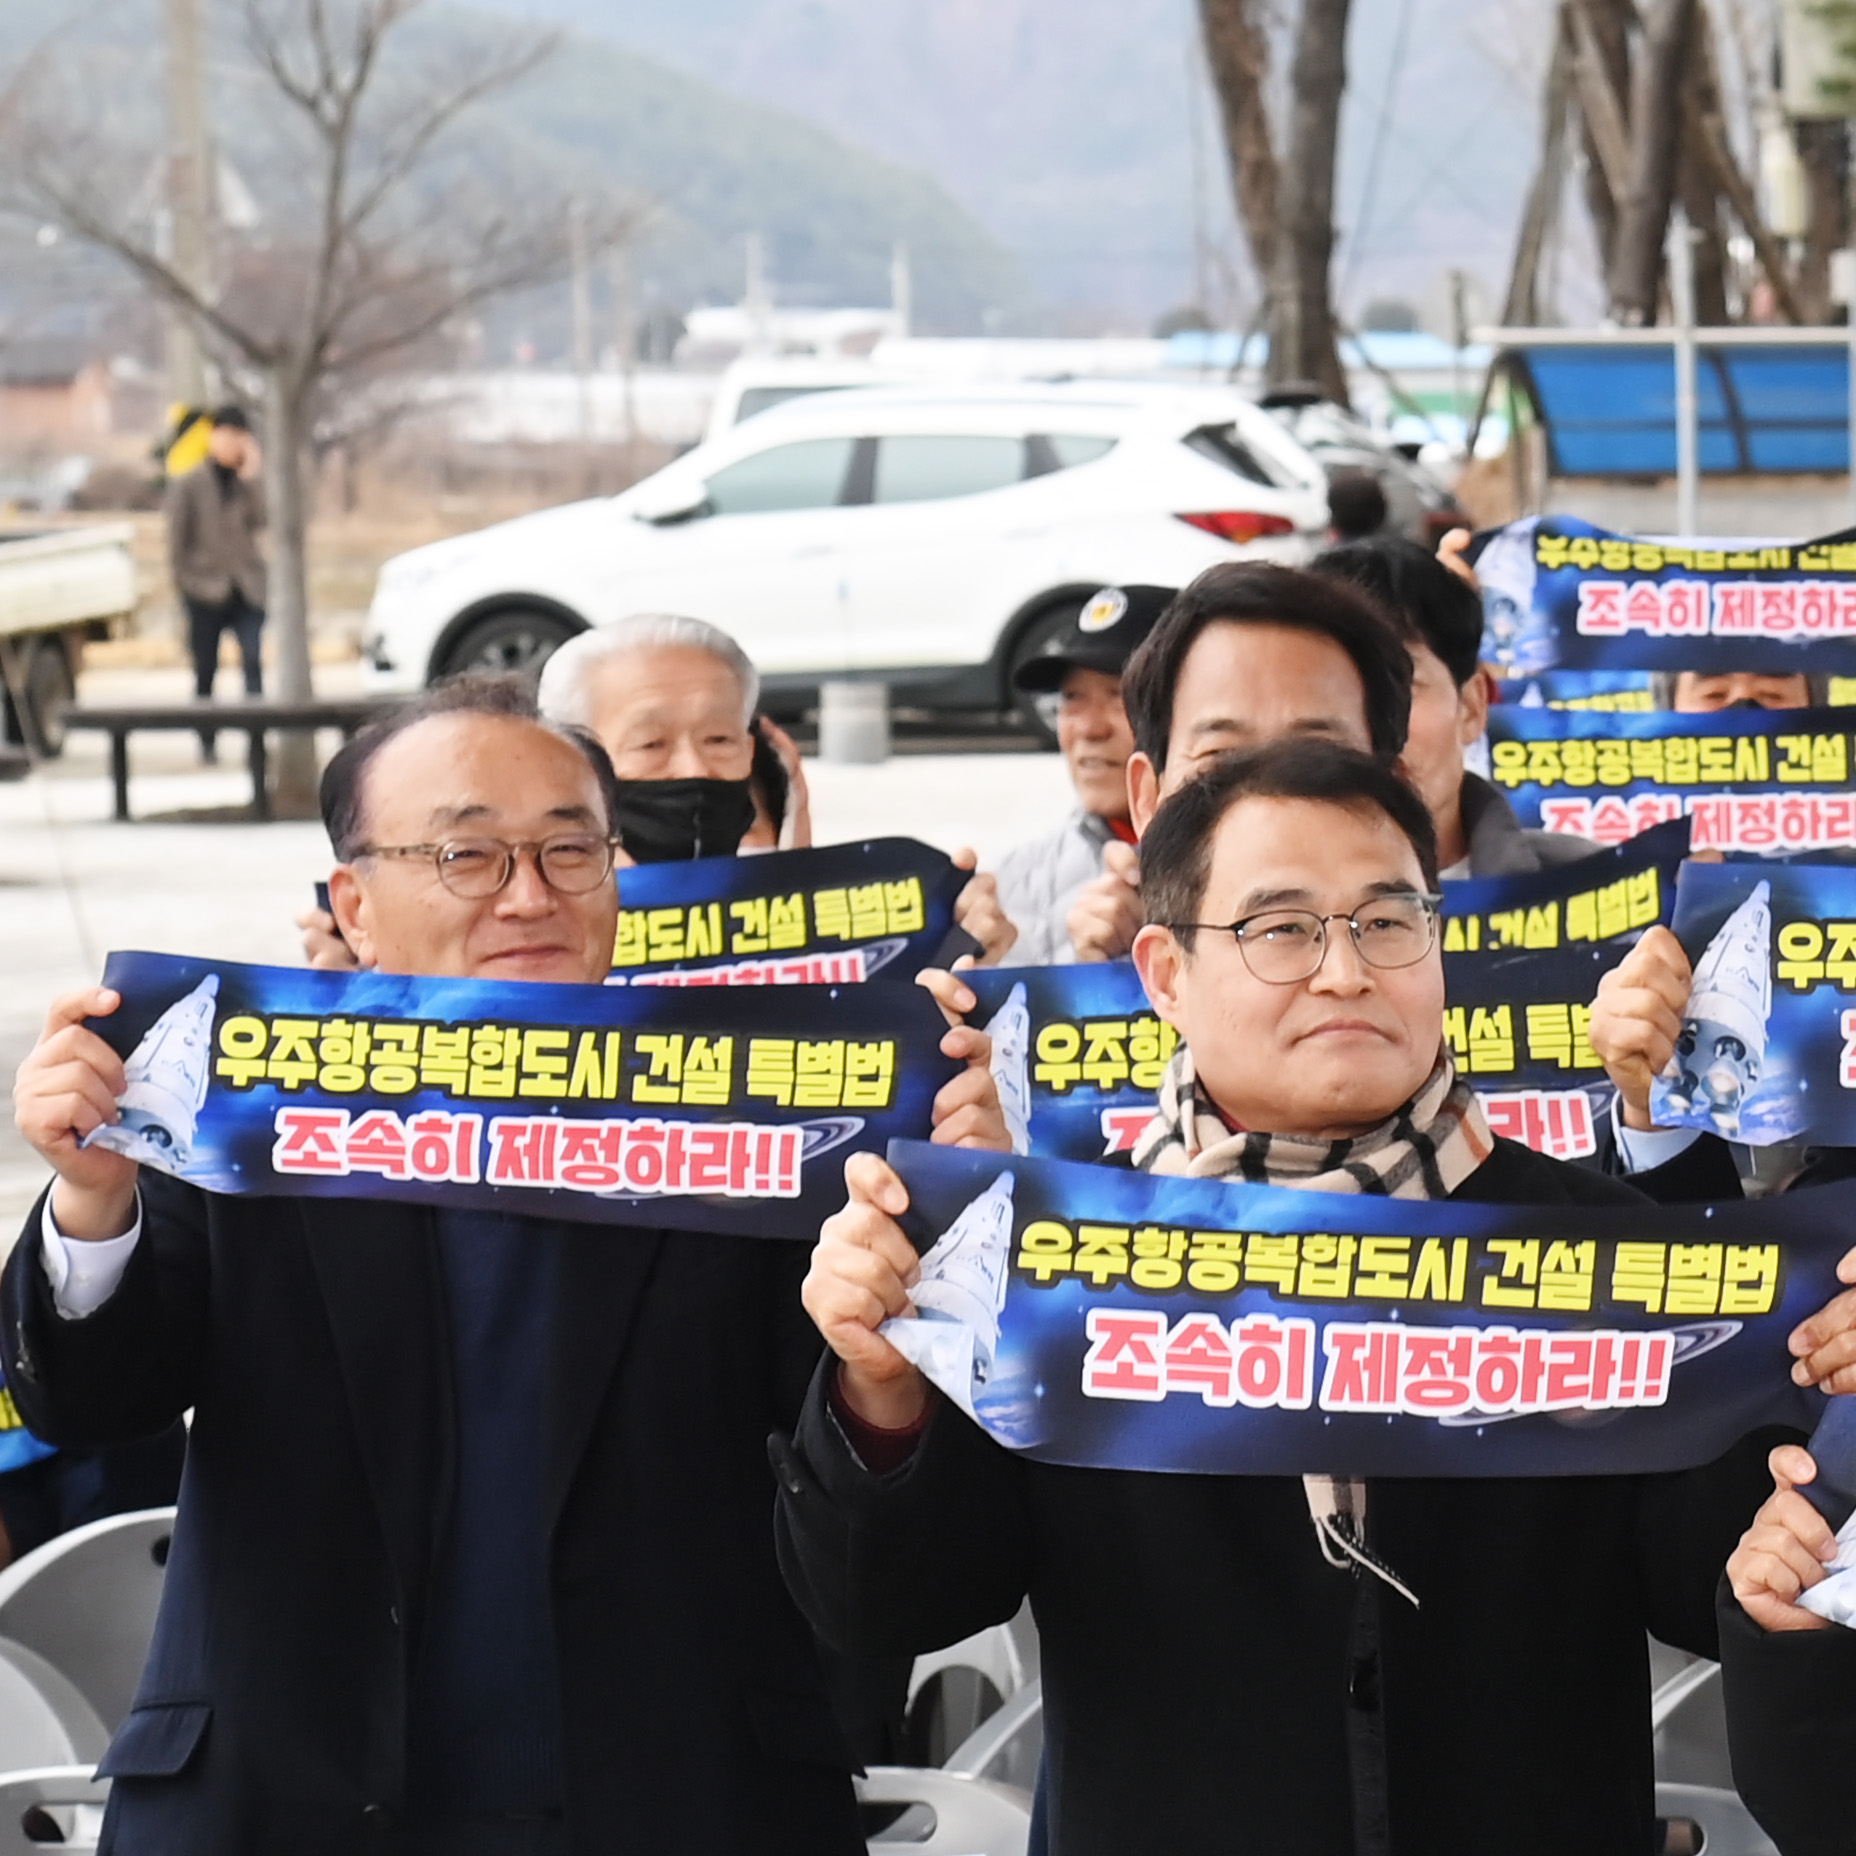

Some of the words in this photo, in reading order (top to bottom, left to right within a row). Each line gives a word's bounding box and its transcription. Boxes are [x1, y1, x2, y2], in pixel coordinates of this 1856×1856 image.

[1583, 584, 1707, 631] 조속히
[1493, 735, 1770, 788] 우주항공복합도시
[1776, 733, 1848, 783] 건설
[730, 892, 807, 954] 건설
[813, 877, 924, 941] 특별법
[1566, 867, 1659, 942] 특별법
[218, 1015, 621, 1100] 우주항공복합도시
[633, 1034, 734, 1106] 건설
[747, 1038, 895, 1107] 특별법
[1526, 1003, 1604, 1069] 특별
[279, 1111, 478, 1180] 조속히
[492, 1120, 799, 1194] 제정하라!!
[1019, 1220, 1469, 1302] 우주항공복합도시
[1483, 1239, 1596, 1311] 건설
[1612, 1242, 1779, 1315] 특별법
[1089, 1315, 1309, 1403] 조속히
[1326, 1329, 1669, 1411] 제정하라!!
